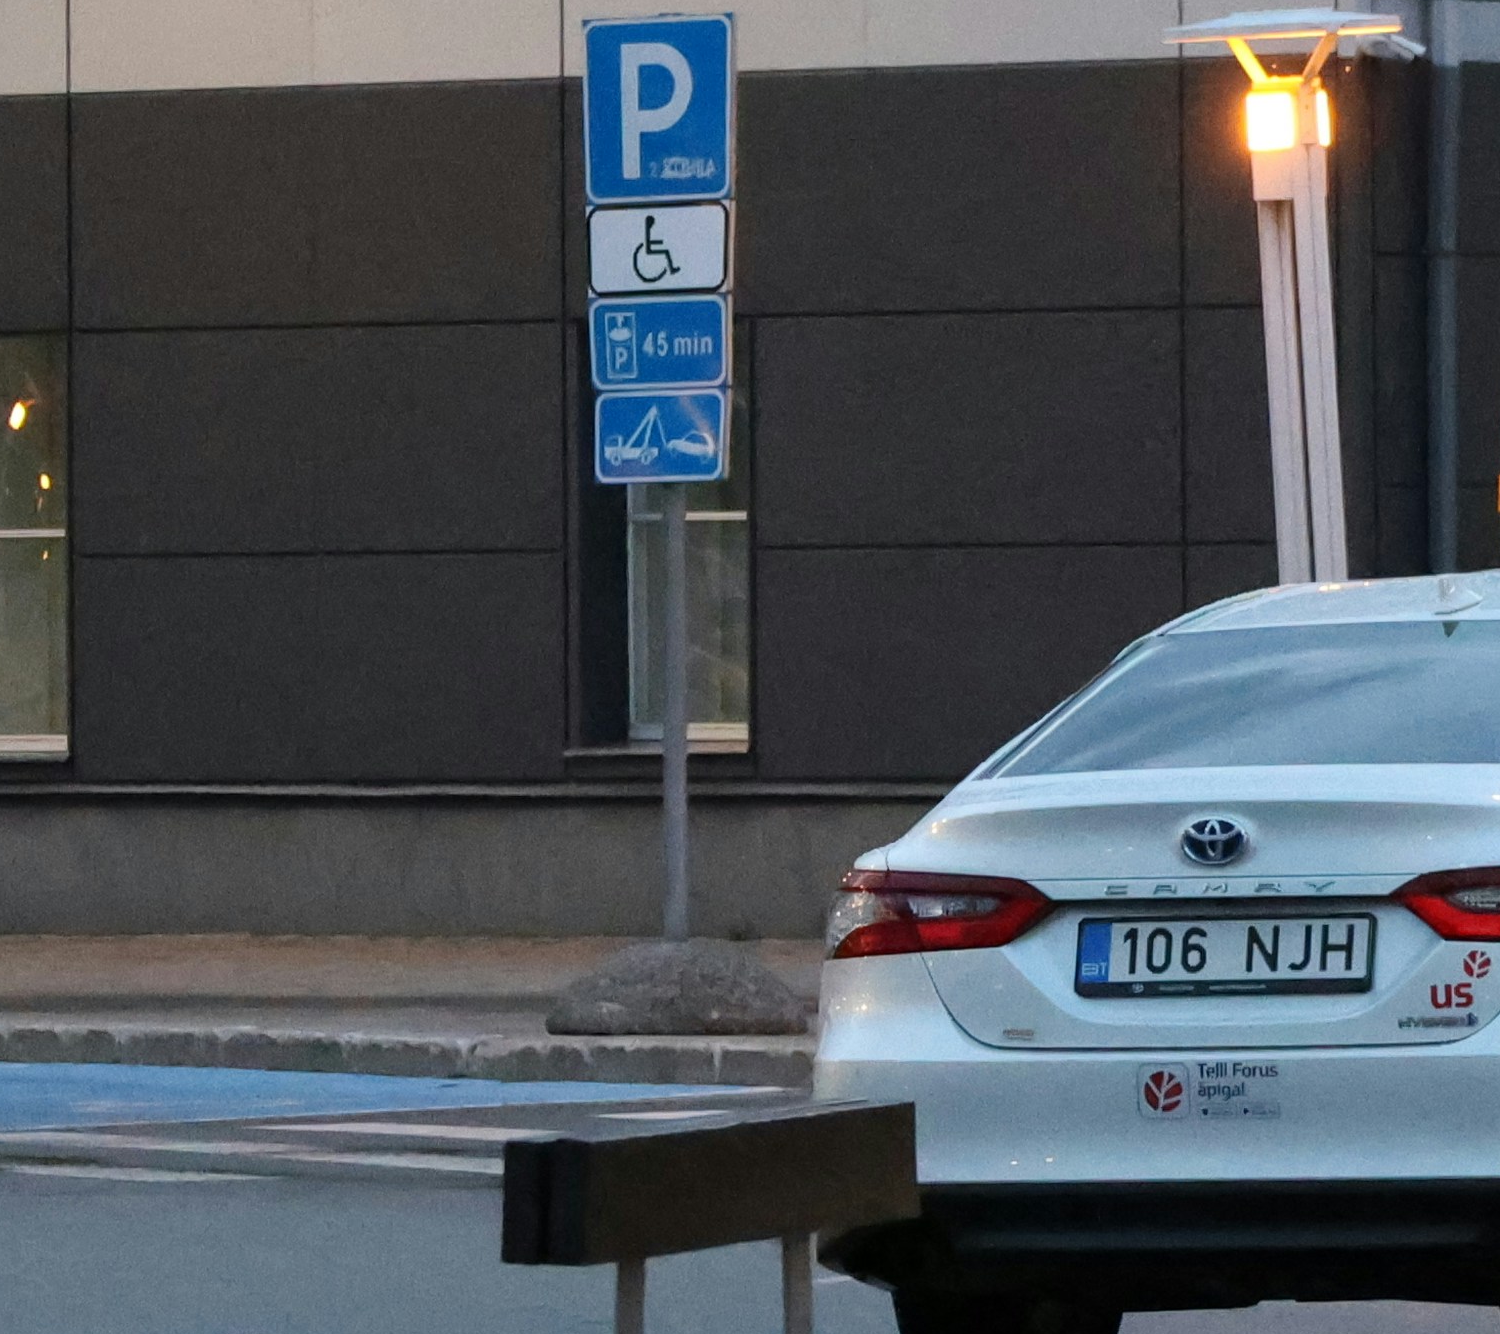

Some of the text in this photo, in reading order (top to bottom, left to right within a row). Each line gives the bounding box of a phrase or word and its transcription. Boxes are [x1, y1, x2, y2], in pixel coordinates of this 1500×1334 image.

[620, 41, 694, 181] P
[641, 330, 714, 358] 45 min
[1104, 880, 1336, 896] CAMRY
[1122, 923, 1355, 975] 106 NJH
[1232, 1062, 1279, 1079] Forus
